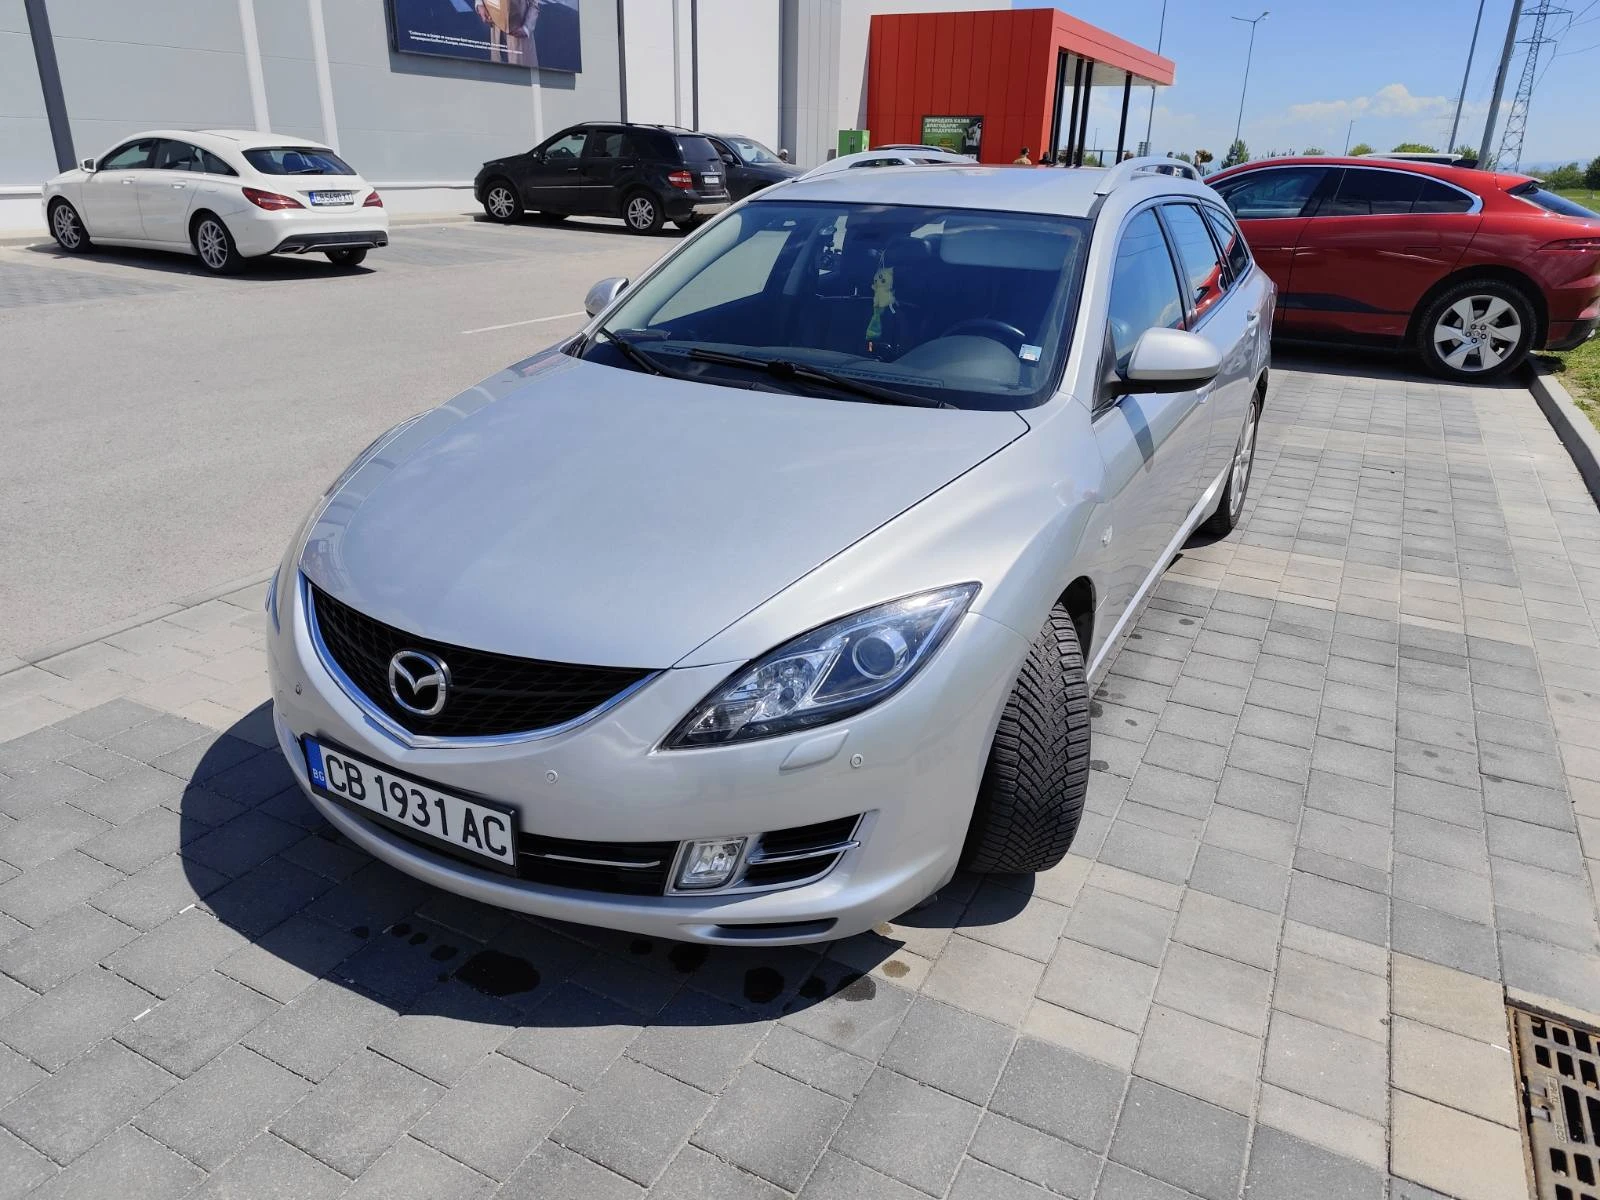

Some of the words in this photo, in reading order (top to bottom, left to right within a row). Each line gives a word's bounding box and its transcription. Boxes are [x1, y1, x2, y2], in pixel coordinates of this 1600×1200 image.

[312, 767, 325, 782] BG
[326, 754, 366, 800] CB
[374, 774, 449, 837] 1931
[462, 807, 507, 857] AC
